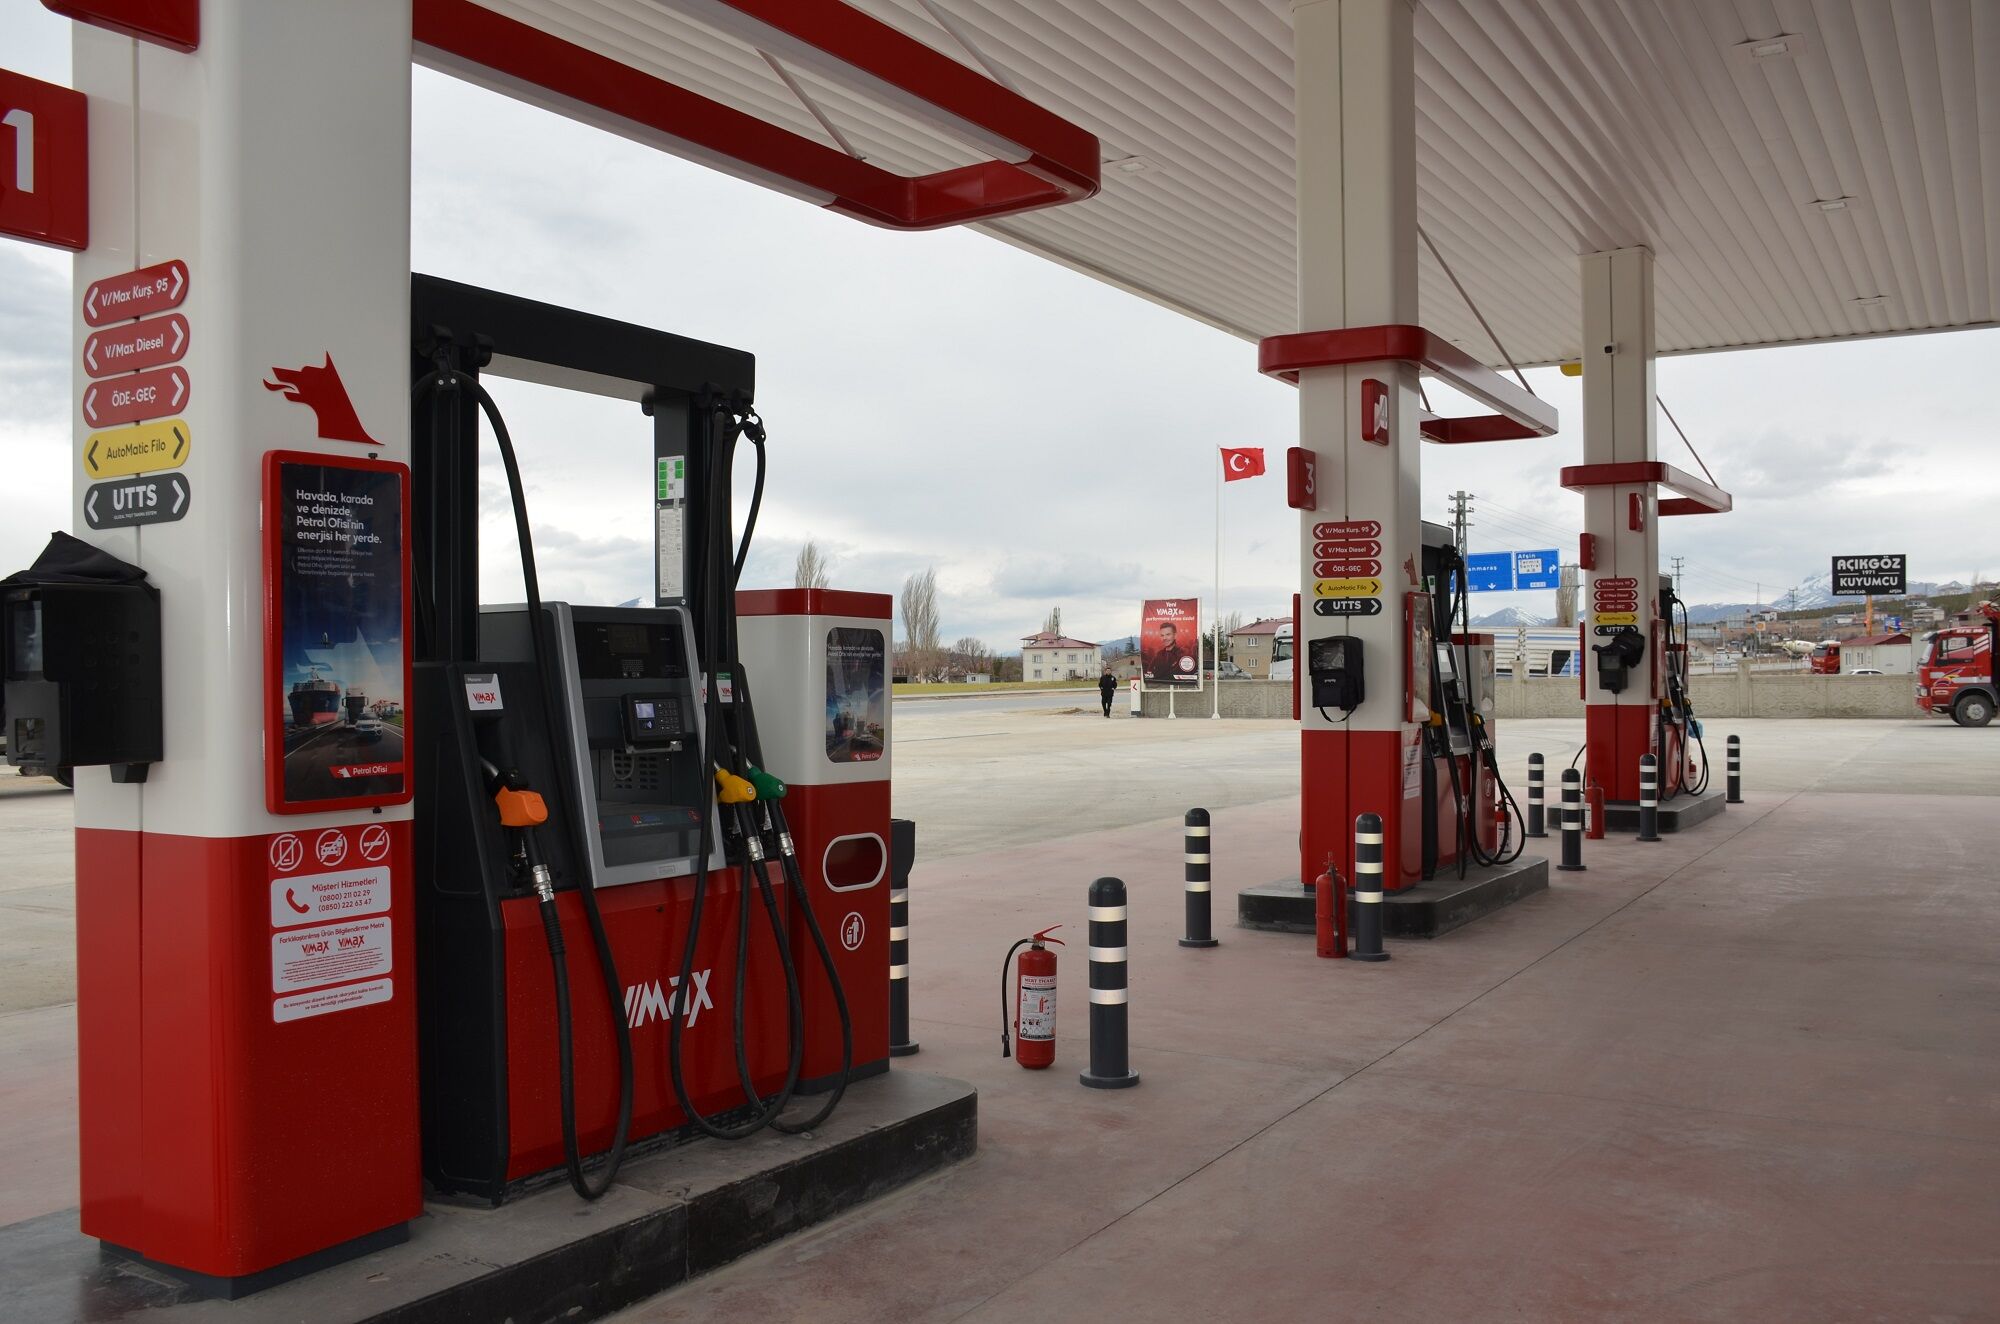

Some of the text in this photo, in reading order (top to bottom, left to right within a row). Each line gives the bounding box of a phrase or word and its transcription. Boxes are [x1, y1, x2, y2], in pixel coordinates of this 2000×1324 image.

[1, 108, 34, 194] 1
[102, 277, 168, 307] V/Max Kurş. 95
[105, 333, 164, 359] V/Max Diesel
[111, 386, 157, 407] ÖDE-GEÇ
[106, 438, 166, 460] AutoMatic Filo
[1305, 462, 1314, 495] 3
[113, 483, 157, 511] UTTS
[296, 489, 374, 505] Havada, karada
[297, 504, 353, 517] ve denizde,
[296, 515, 364, 530] Petrol Ofisi'nin
[297, 530, 382, 544] enerjisi her yerde.
[1837, 555, 1901, 572] AÇIKGÖZ
[1839, 576, 1898, 587] KUYUMCU
[1332, 600, 1362, 610] UTTS
[353, 765, 388, 775] Petrol Ofisi
[312, 877, 378, 893] Müşteri Hizmetleri
[319, 889, 371, 903] (0800) 211 02 29
[318, 902, 341, 912] (0850)
[341, 901, 354, 909] 222
[364, 898, 372, 906] 47
